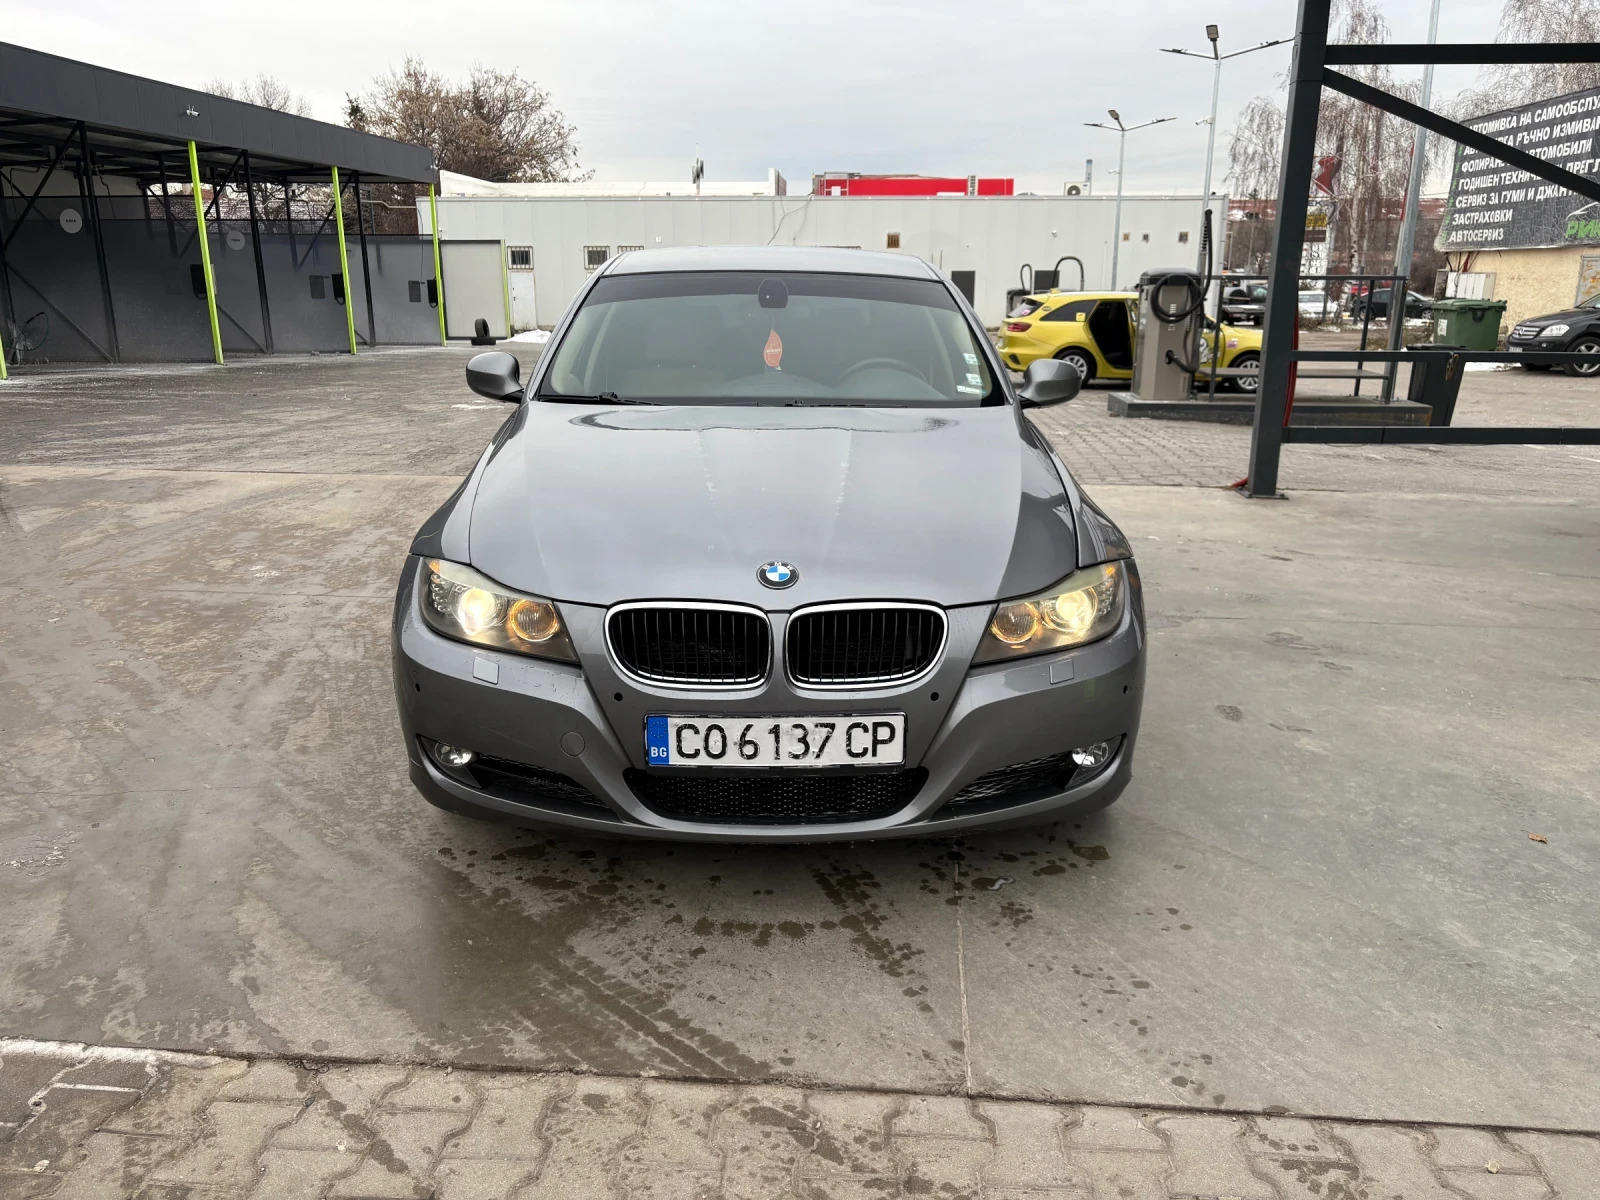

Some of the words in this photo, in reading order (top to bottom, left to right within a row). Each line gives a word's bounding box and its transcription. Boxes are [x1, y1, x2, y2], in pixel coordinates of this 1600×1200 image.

[1519, 112, 1532, 127] НА
[1516, 126, 1551, 146] РЪЧНО
[1458, 174, 1500, 191] ГОДИШЕН
[1455, 193, 1487, 208] СЕРВИЗ
[1489, 191, 1499, 205] ЗА
[1500, 188, 1526, 204] ГУМИ
[1527, 187, 1535, 201] И
[1452, 209, 1513, 226] ЗАСТРАХОВКИ
[1448, 228, 1504, 243] АВТОСЕРВИЗ
[650, 746, 667, 758] BG
